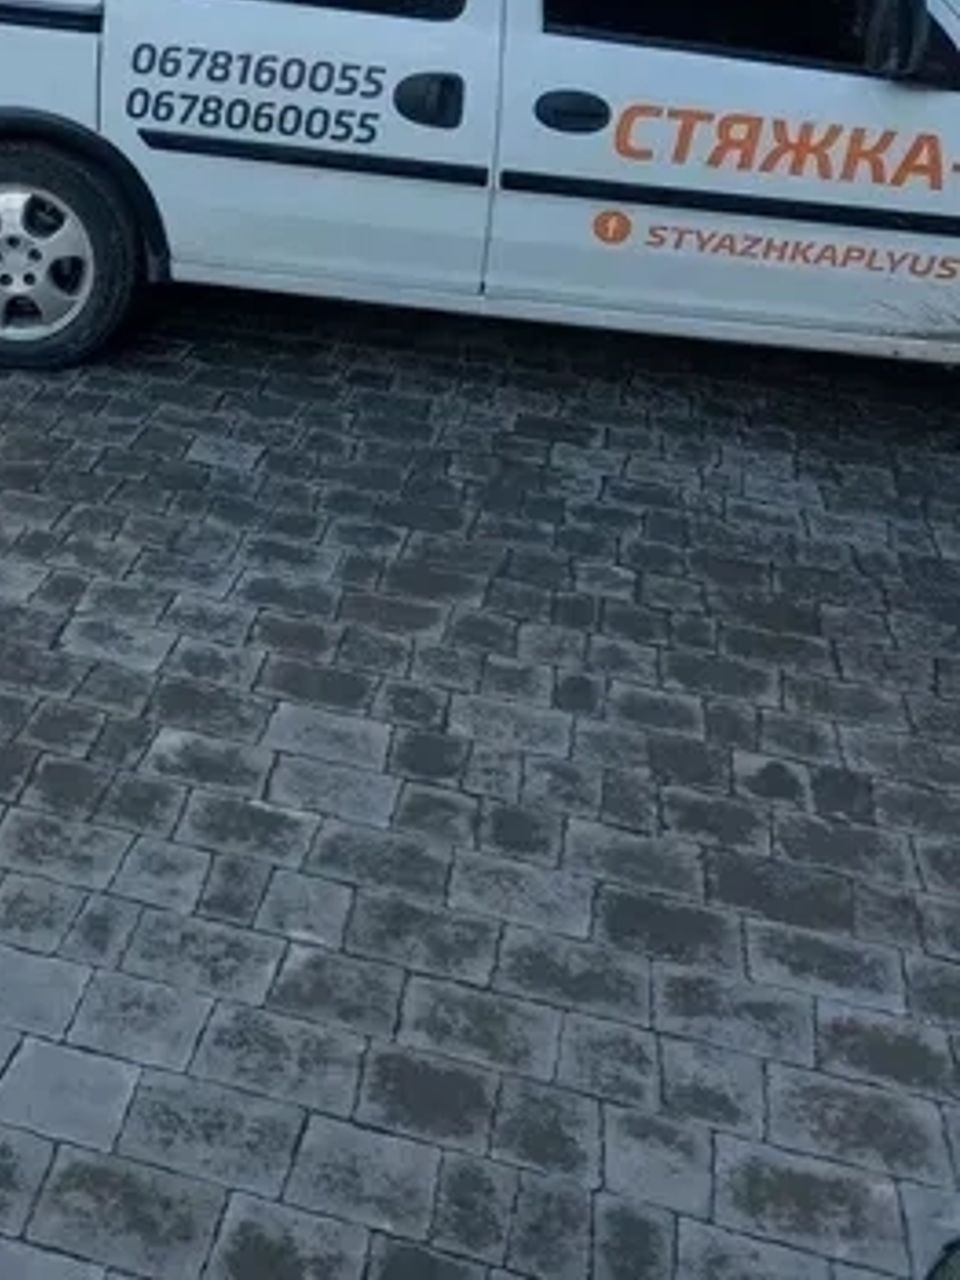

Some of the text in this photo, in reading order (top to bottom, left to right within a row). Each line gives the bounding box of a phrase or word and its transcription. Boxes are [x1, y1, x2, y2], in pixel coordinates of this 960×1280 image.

[132, 42, 387, 99] 0678160055
[125, 87, 381, 145] 0678060055
[645, 224, 960, 280] STYAZHKAPLYUS
